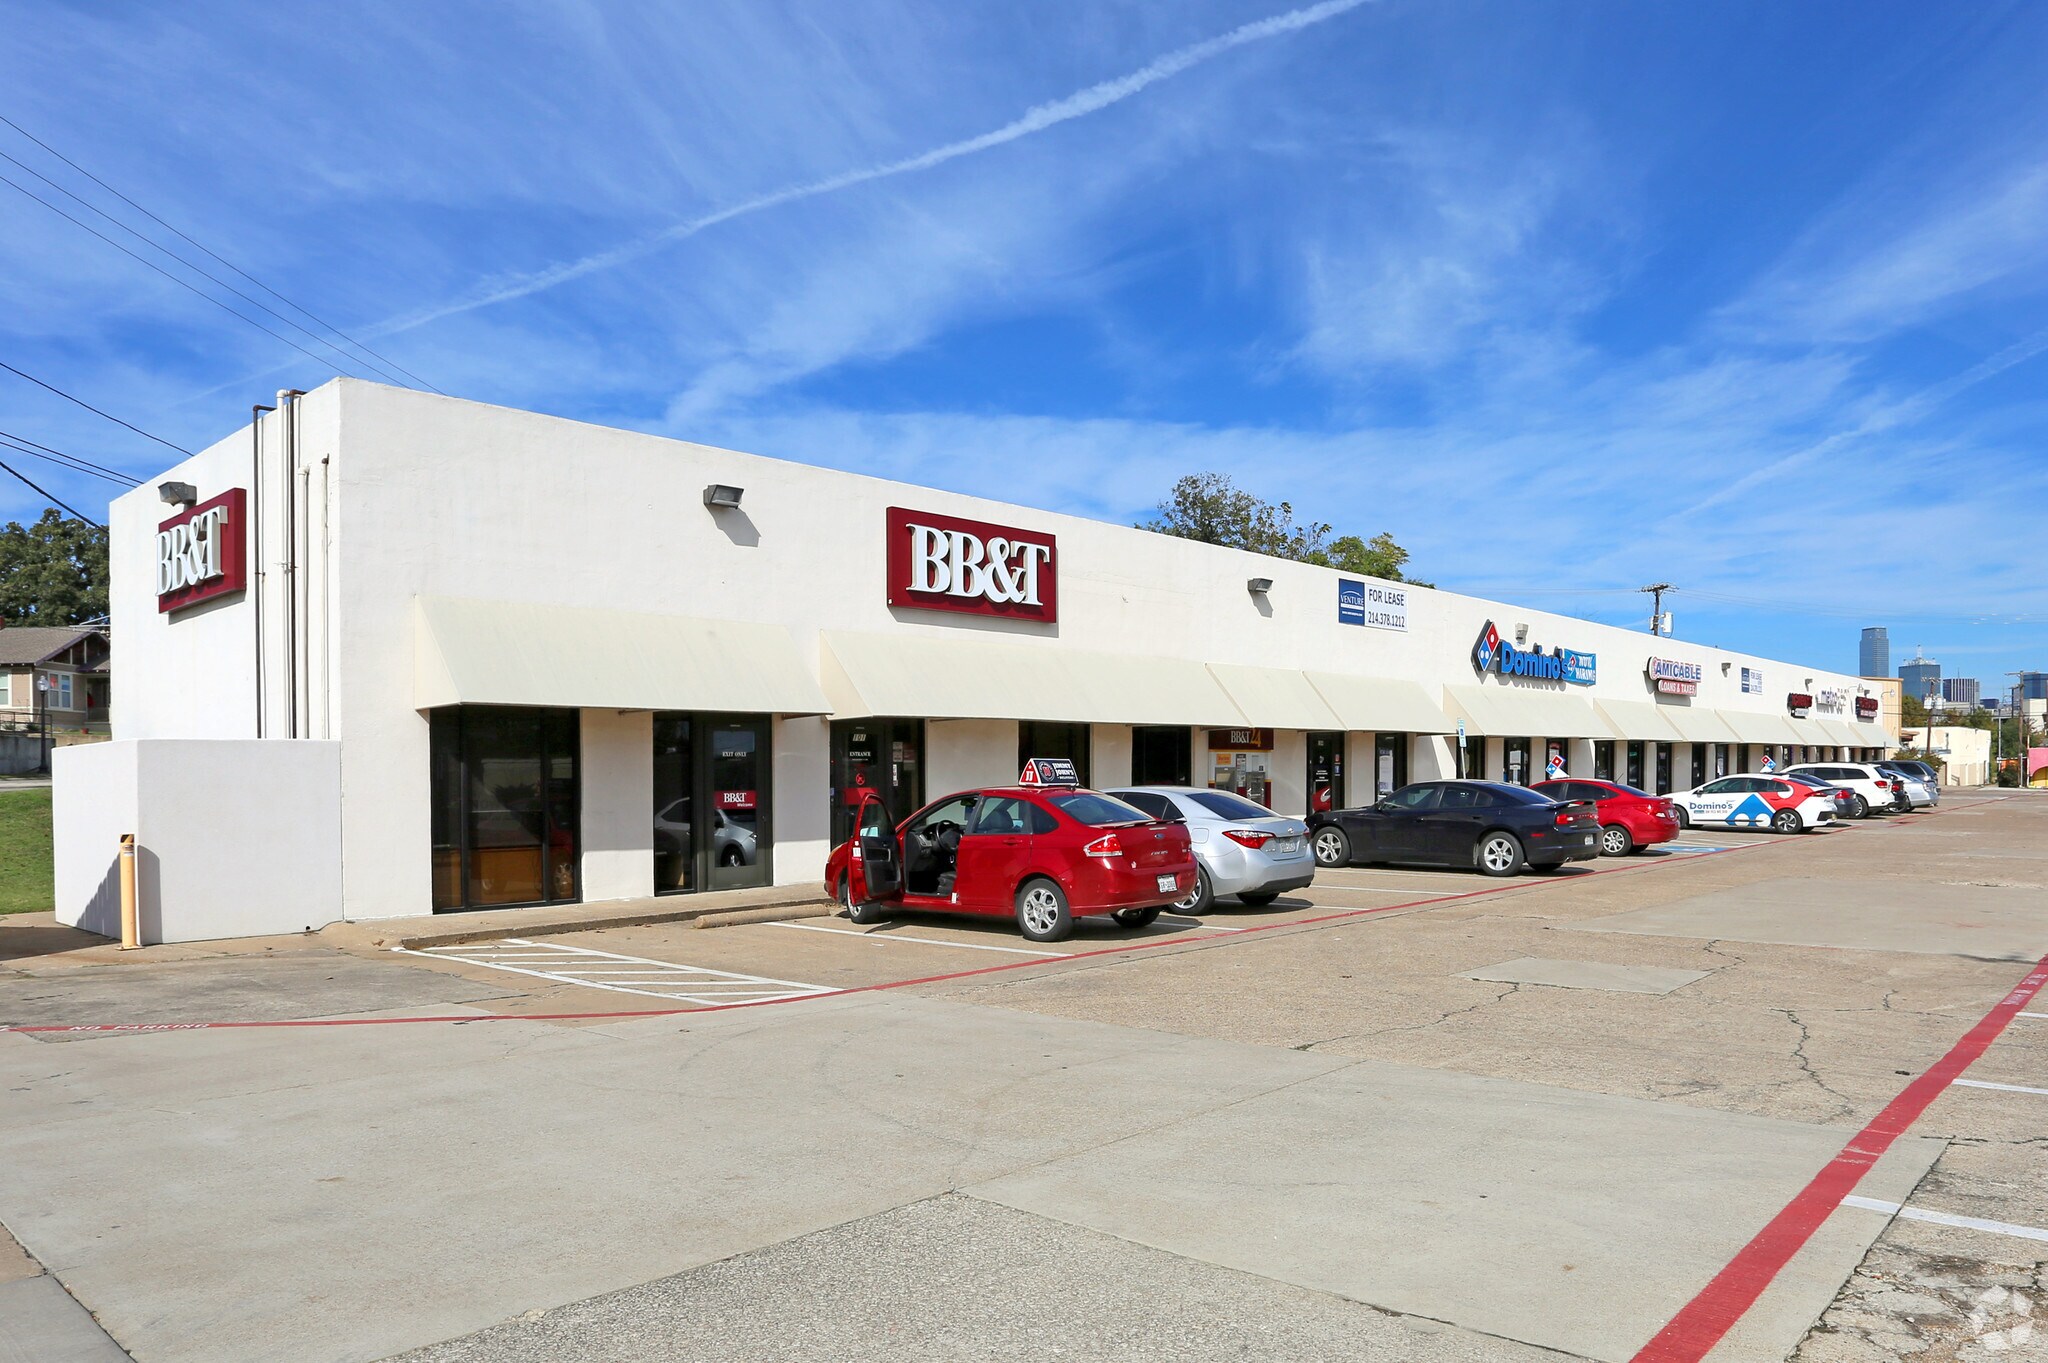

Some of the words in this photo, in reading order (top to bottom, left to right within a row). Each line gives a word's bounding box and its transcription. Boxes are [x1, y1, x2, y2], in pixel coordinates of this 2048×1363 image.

[155, 505, 228, 596] BB&T
[906, 523, 1050, 606] BB&T
[1340, 594, 1364, 606] VENTURE
[1368, 588, 1383, 603] FOR
[1384, 591, 1405, 606] LEASE
[1368, 611, 1405, 628] 214.378.1212
[1501, 641, 1568, 681] Domino's
[1655, 660, 1702, 680] AMICABLE
[1660, 681, 1676, 693] LOANS
[723, 792, 747, 803] BB&T
[1689, 802, 1733, 810] Domino's
